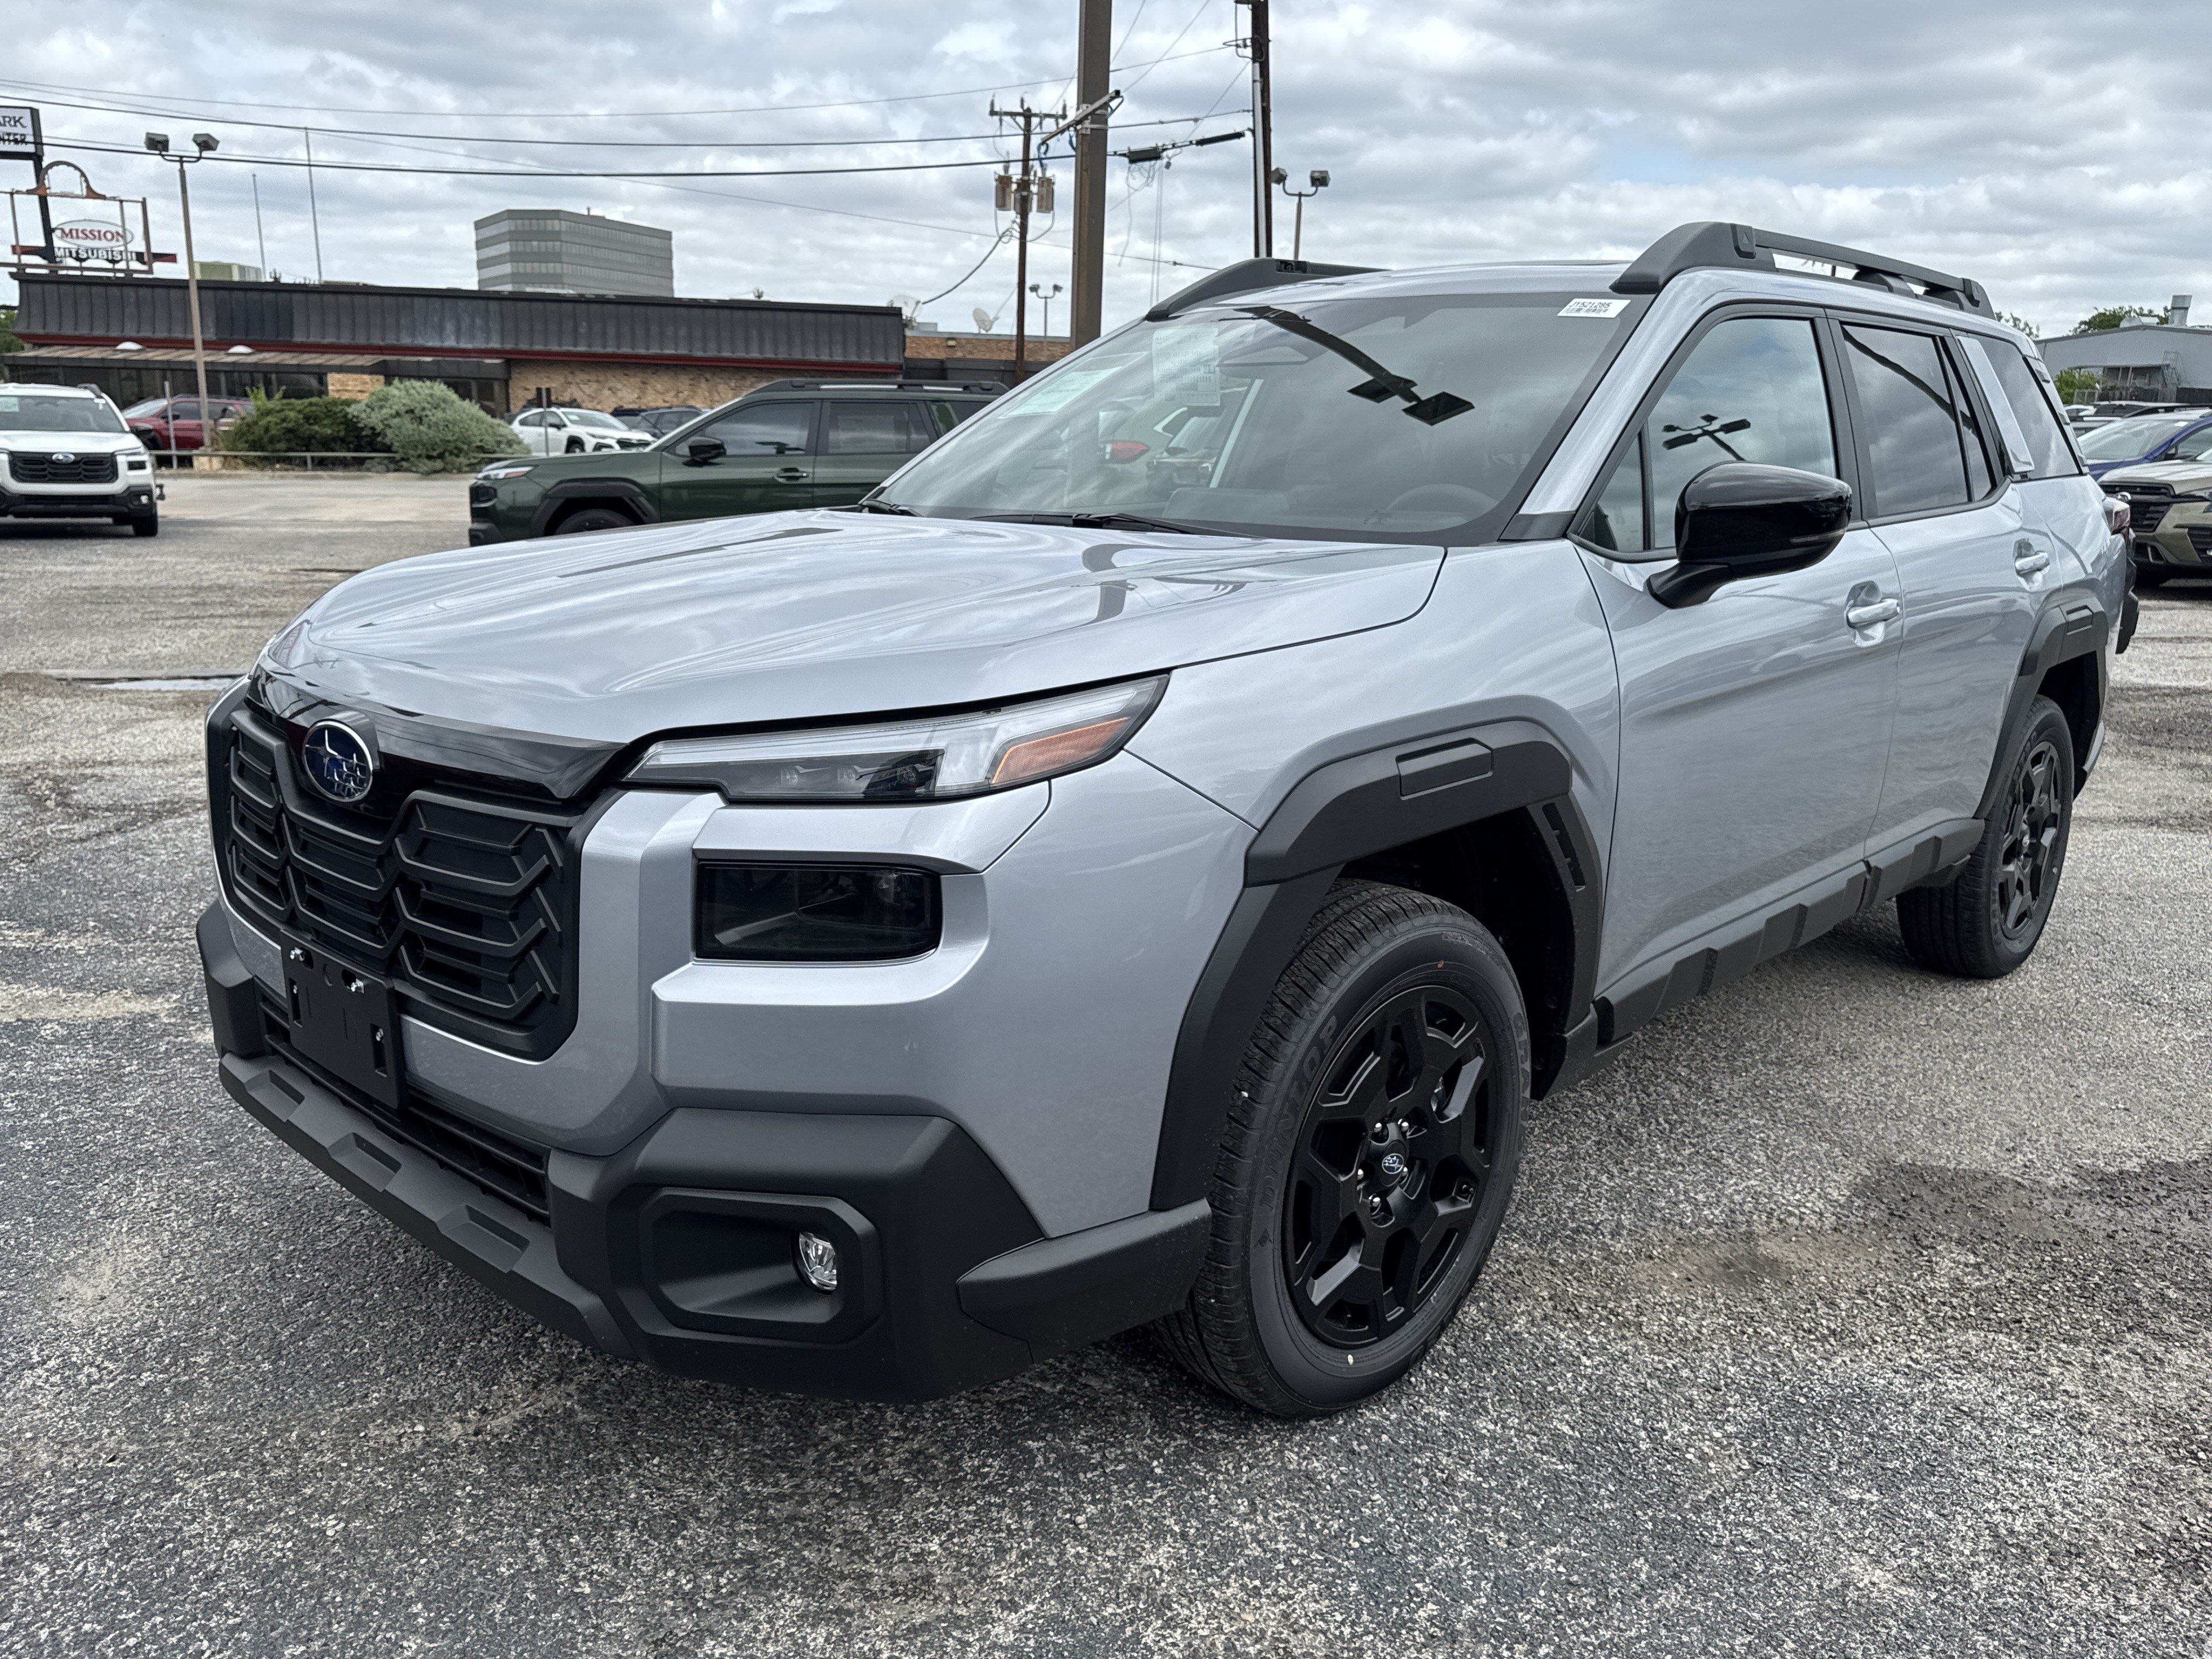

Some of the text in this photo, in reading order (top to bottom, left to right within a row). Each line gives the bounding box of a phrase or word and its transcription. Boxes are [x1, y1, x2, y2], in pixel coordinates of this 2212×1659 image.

[0, 115, 27, 128] RK
[60, 228, 125, 242] MISSION
[54, 247, 137, 261] MITSUBISHI
[1262, 1015, 1337, 1212] DUNLOP
